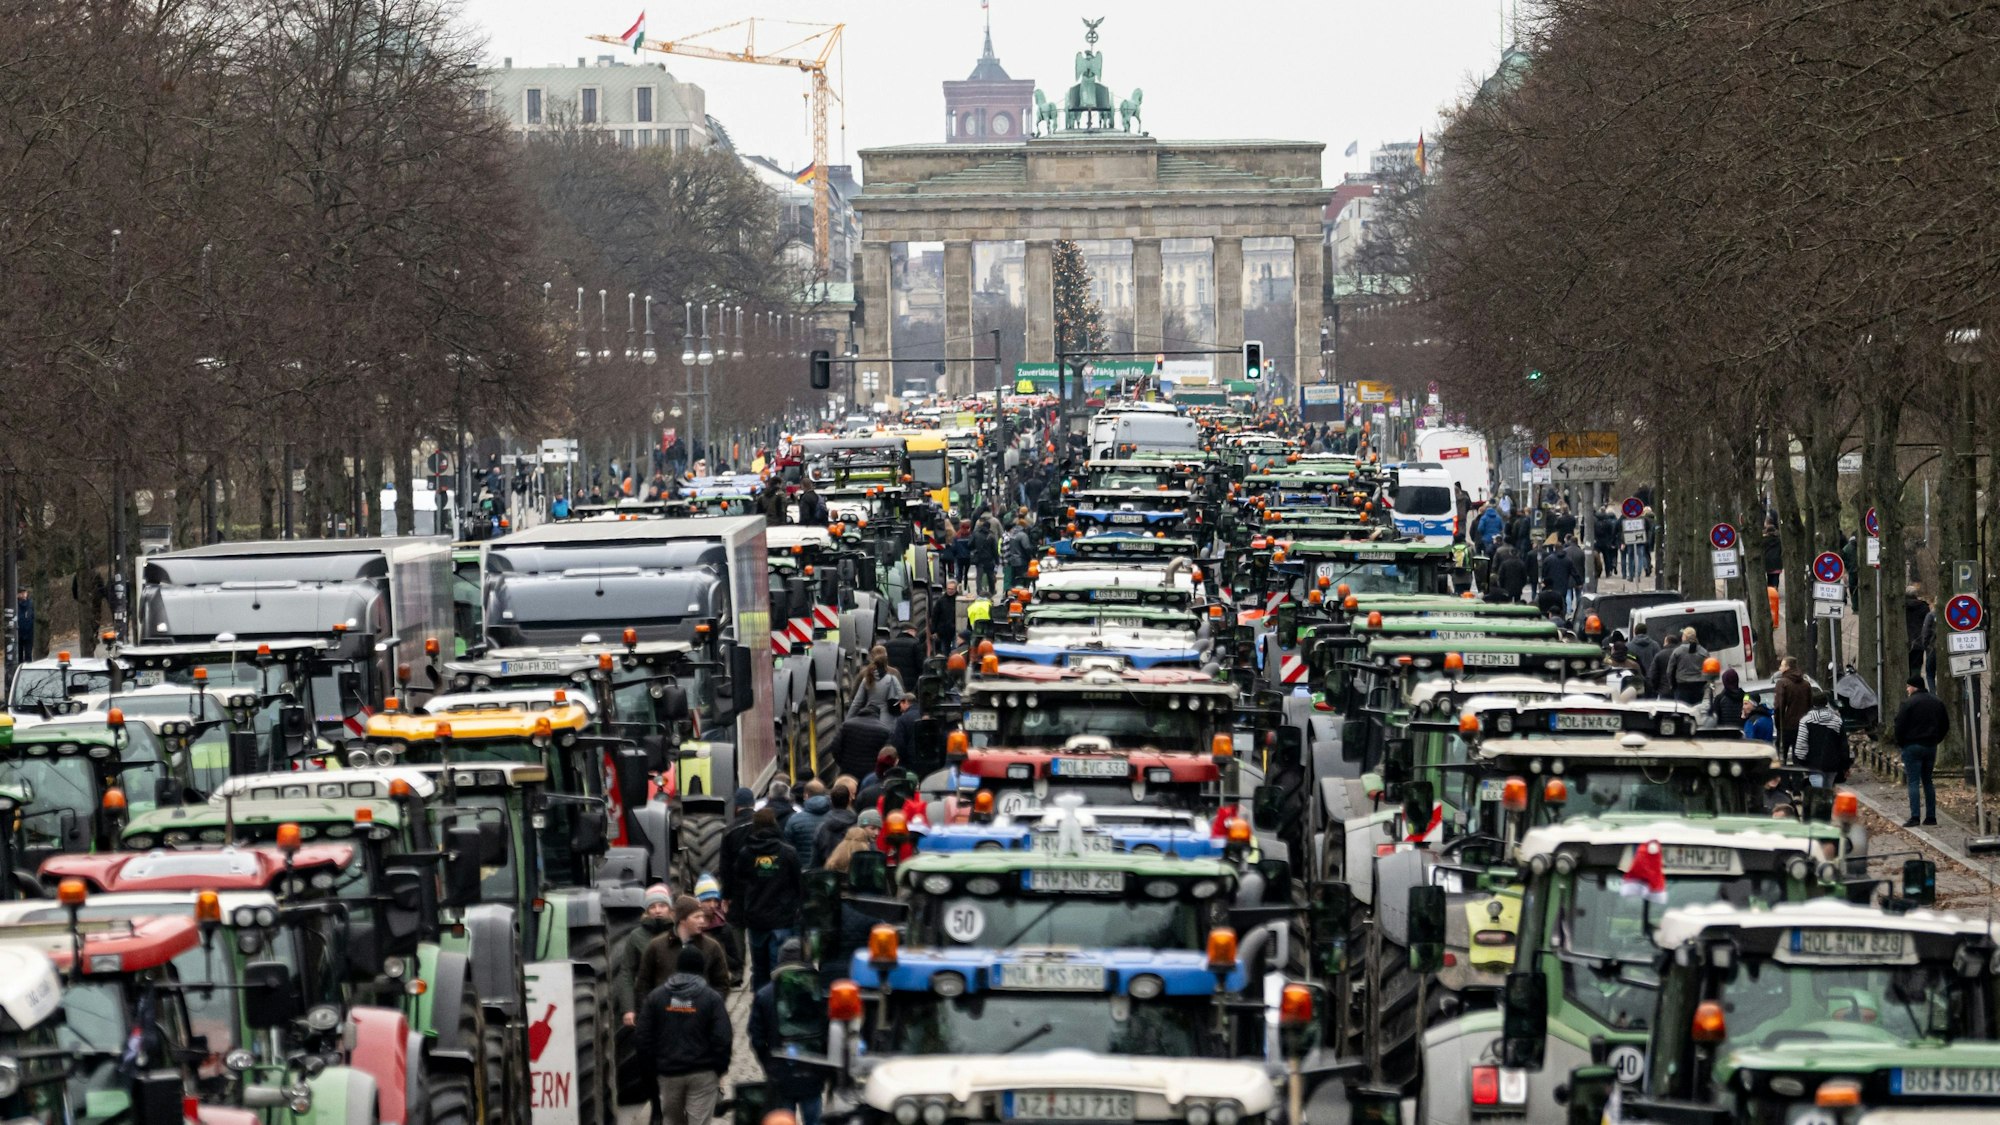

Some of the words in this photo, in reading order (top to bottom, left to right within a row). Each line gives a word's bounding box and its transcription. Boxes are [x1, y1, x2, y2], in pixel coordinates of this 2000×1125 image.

[1116, 367, 1131, 375] und
[1573, 464, 1613, 474] Reichstag
[1534, 510, 1543, 525] P
[1320, 566, 1331, 577] 50
[1958, 564, 1972, 588] P
[507, 662, 524, 673] ROW
[528, 661, 540, 671] FH
[541, 661, 557, 671] 301
[1467, 655, 1480, 665] FF
[1488, 655, 1502, 665] DM
[1503, 655, 1515, 665] 31
[1557, 715, 1579, 728] MOL
[1605, 716, 1620, 728] 42
[1060, 761, 1080, 774] MOL
[1106, 761, 1126, 774] 333
[1004, 798, 1022, 814] 40
[1709, 849, 1727, 865] 10
[1032, 871, 1060, 889] FRW
[1094, 872, 1120, 889] 250
[953, 909, 975, 934] 50
[1804, 932, 1833, 949] MOL
[1846, 933, 1867, 950] MW
[1870, 934, 1900, 950] 828
[1003, 966, 1033, 986] MOL
[1046, 966, 1067, 986] MS
[1072, 967, 1101, 986] 990
[1617, 1055, 1636, 1076] 40
[1018, 1097, 1042, 1116] AZ
[1056, 1097, 1085, 1116] JJ
[1095, 1097, 1132, 1116] 718
